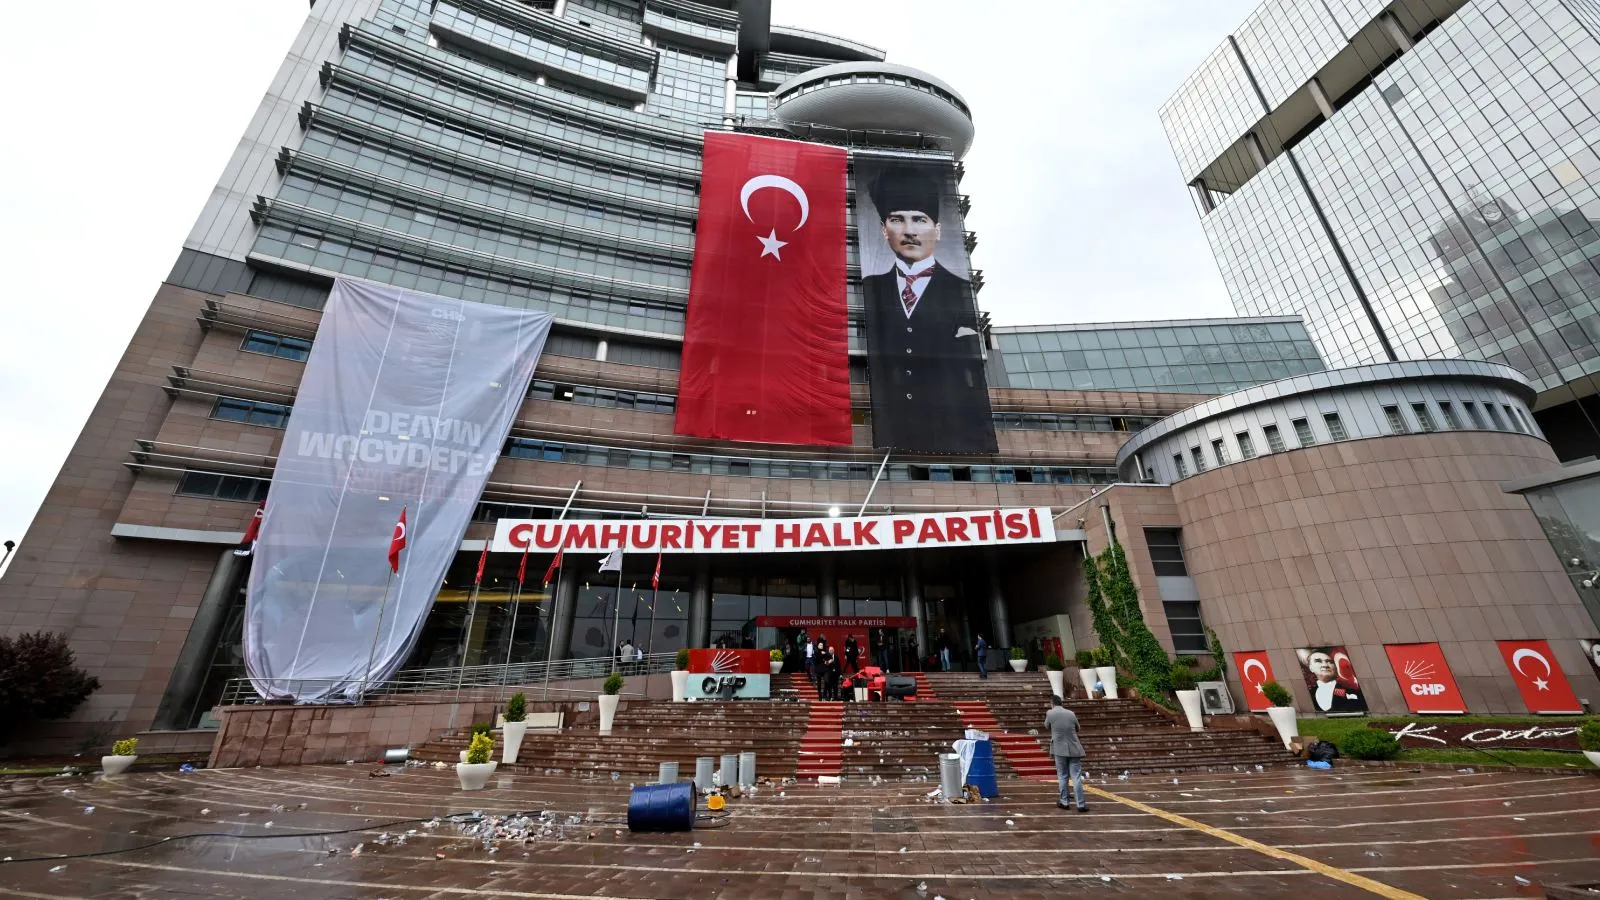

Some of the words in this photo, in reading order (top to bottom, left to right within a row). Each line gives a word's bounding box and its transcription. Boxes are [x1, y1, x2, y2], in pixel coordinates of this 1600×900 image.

[508, 520, 761, 549] CUMHURİYET
[775, 521, 880, 548] HALK
[893, 508, 1041, 544] PARTİSİ
[1411, 683, 1446, 696] CHP
